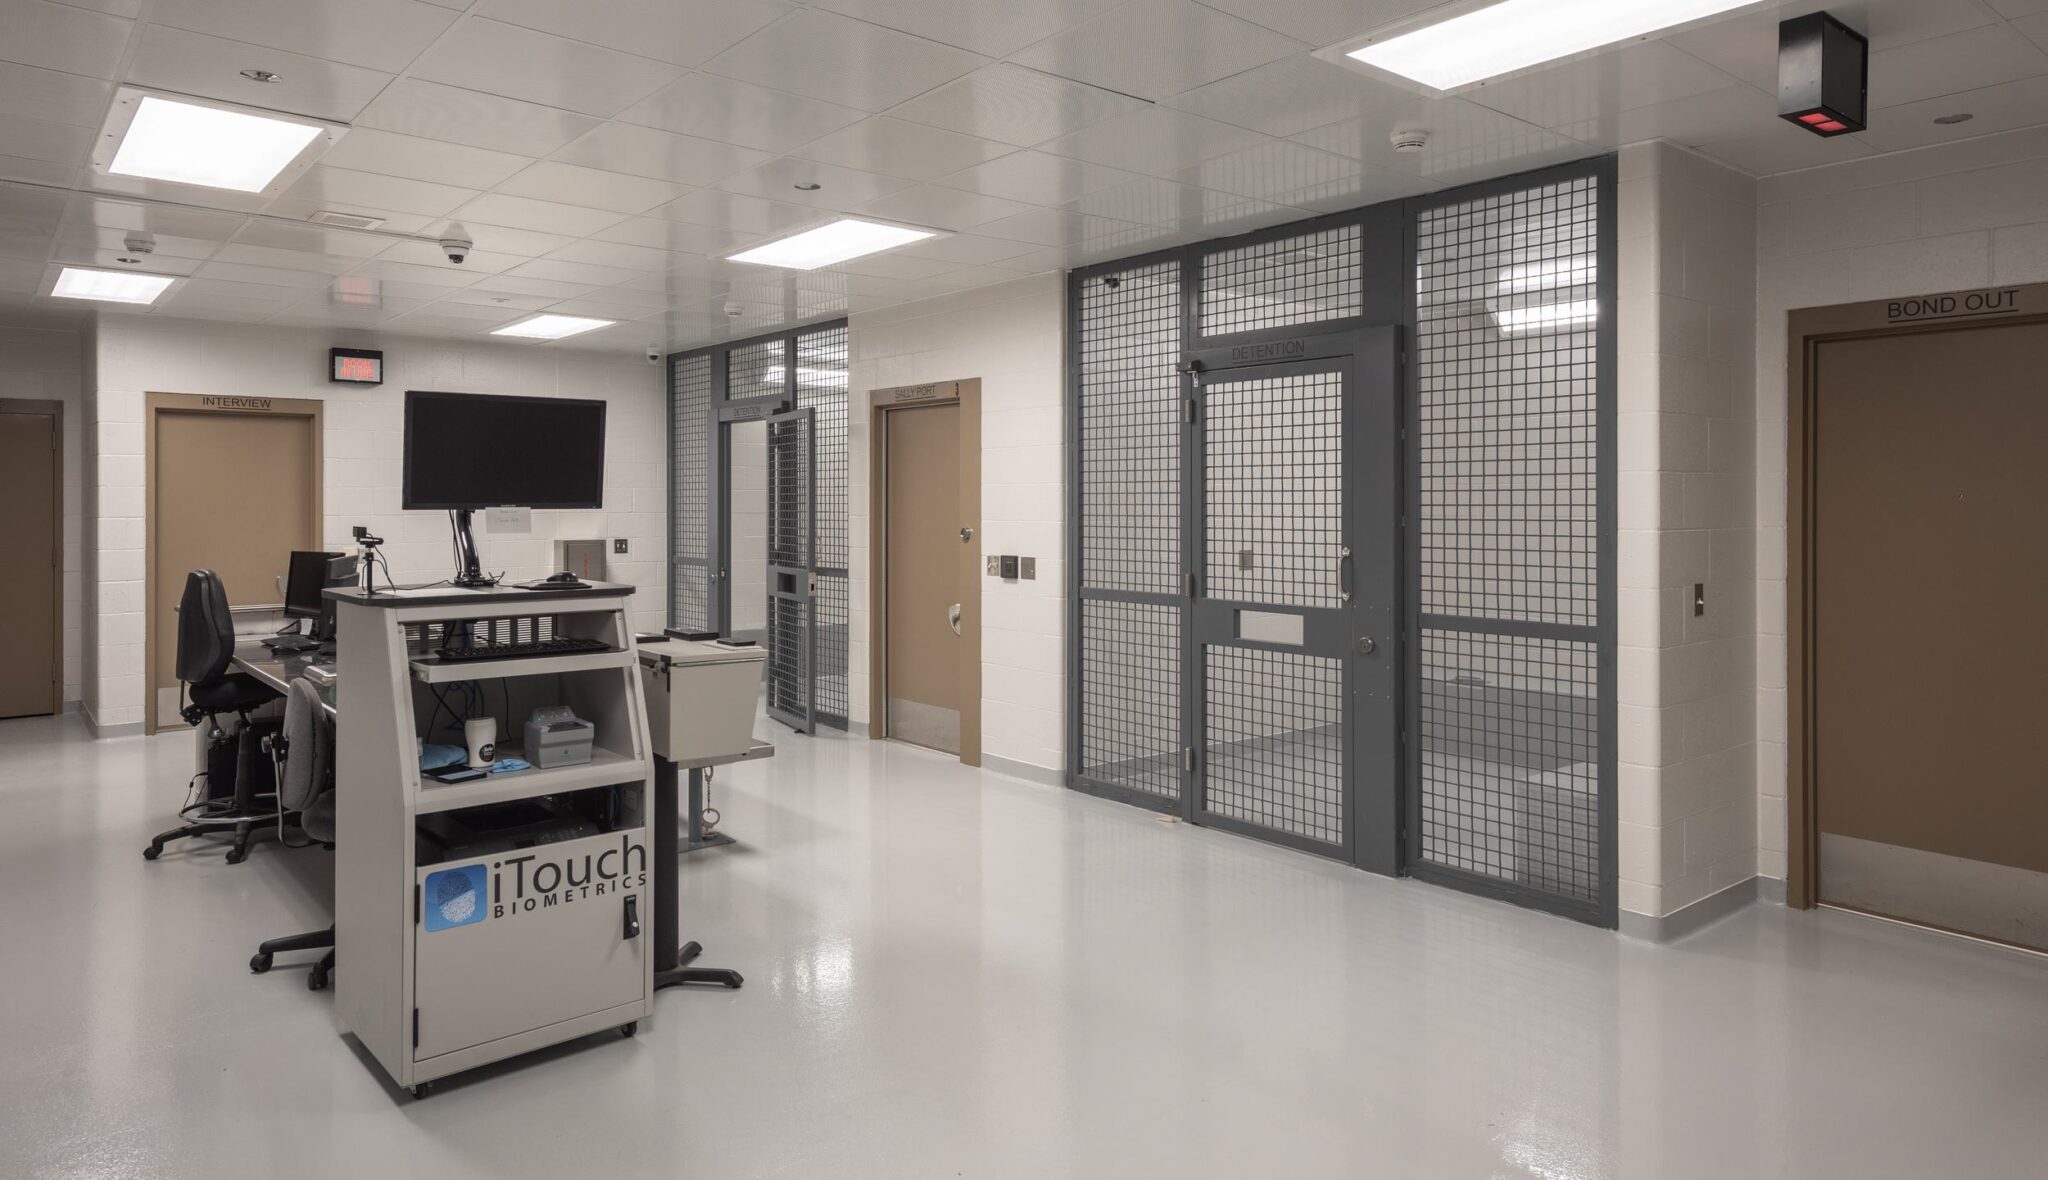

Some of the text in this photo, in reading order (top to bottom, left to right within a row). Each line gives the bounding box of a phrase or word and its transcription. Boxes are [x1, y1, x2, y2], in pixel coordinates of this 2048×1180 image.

[1887, 289, 2020, 319] BOND OUT
[1232, 340, 1305, 361] DETENTION
[202, 396, 273, 409] INTERVIEW
[895, 384, 937, 400] SALLY PORT
[733, 406, 761, 418] DETENTION
[494, 834, 646, 904] iTouch
[494, 872, 647, 919] BIOMETRICS
